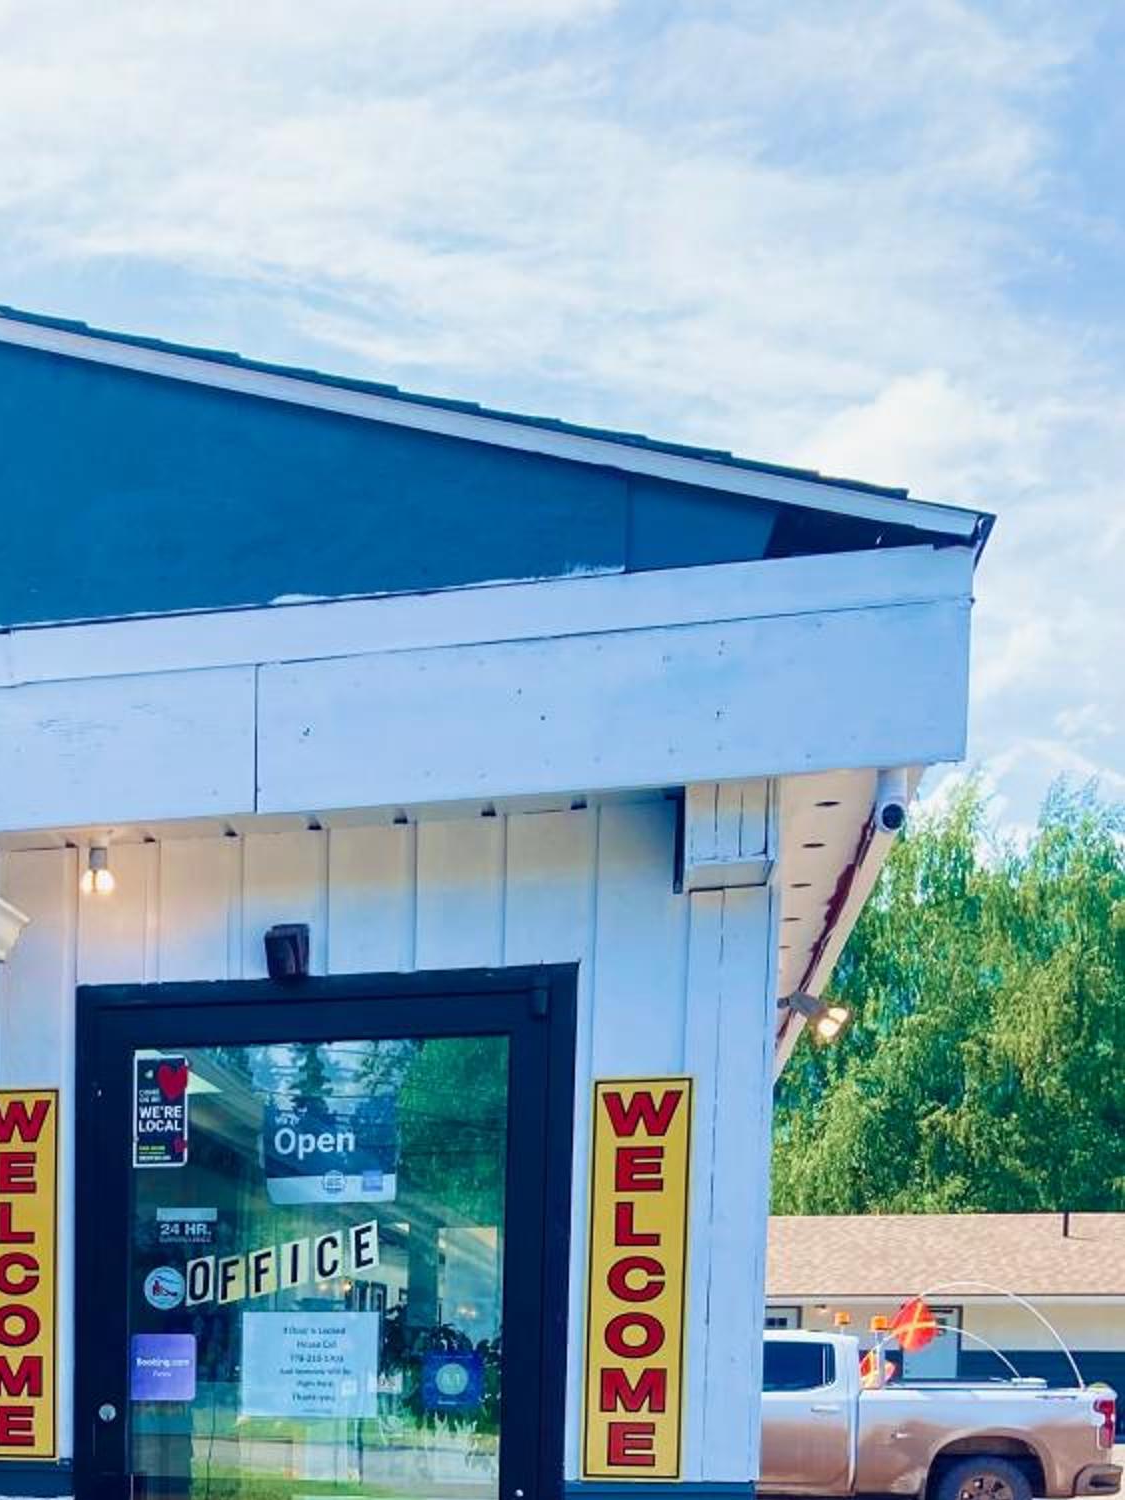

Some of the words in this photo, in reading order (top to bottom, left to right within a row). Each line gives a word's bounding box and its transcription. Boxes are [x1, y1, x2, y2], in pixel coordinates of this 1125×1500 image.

[138, 1105, 182, 1119] WE'RE
[138, 1119, 182, 1132] LOCAL
[274, 1127, 355, 1160] Open
[160, 1223, 180, 1235] 24
[188, 1225, 375, 1301] OFFICE
[599, 1090, 683, 1467] WELCOME
